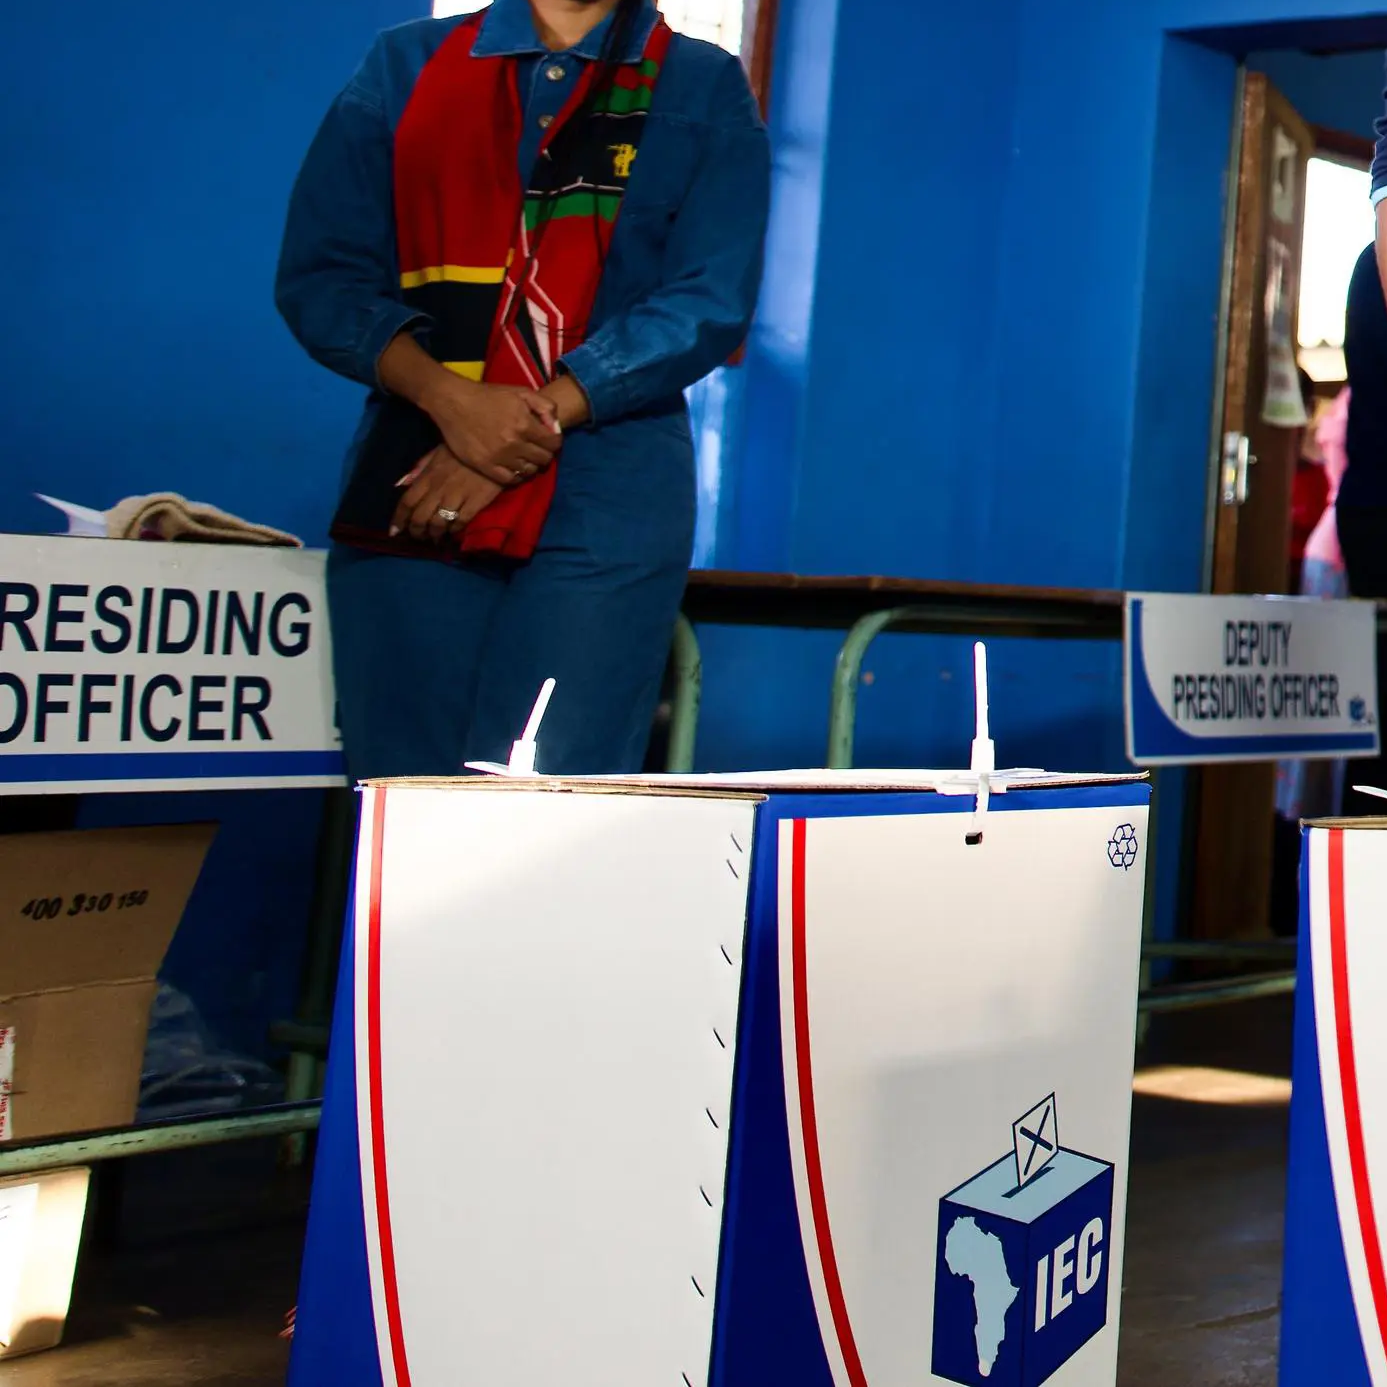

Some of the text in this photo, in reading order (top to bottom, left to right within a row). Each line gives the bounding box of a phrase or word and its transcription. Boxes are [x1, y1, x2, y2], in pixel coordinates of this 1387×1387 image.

[0, 582, 312, 657] RESIDING
[1225, 620, 1292, 666] DEPUTY
[0, 672, 273, 744] OFFICER
[1173, 673, 1266, 720] PRESIDING
[1269, 673, 1341, 719] OFFICER
[20, 896, 63, 921] 400
[1034, 1216, 1104, 1333] IEC
